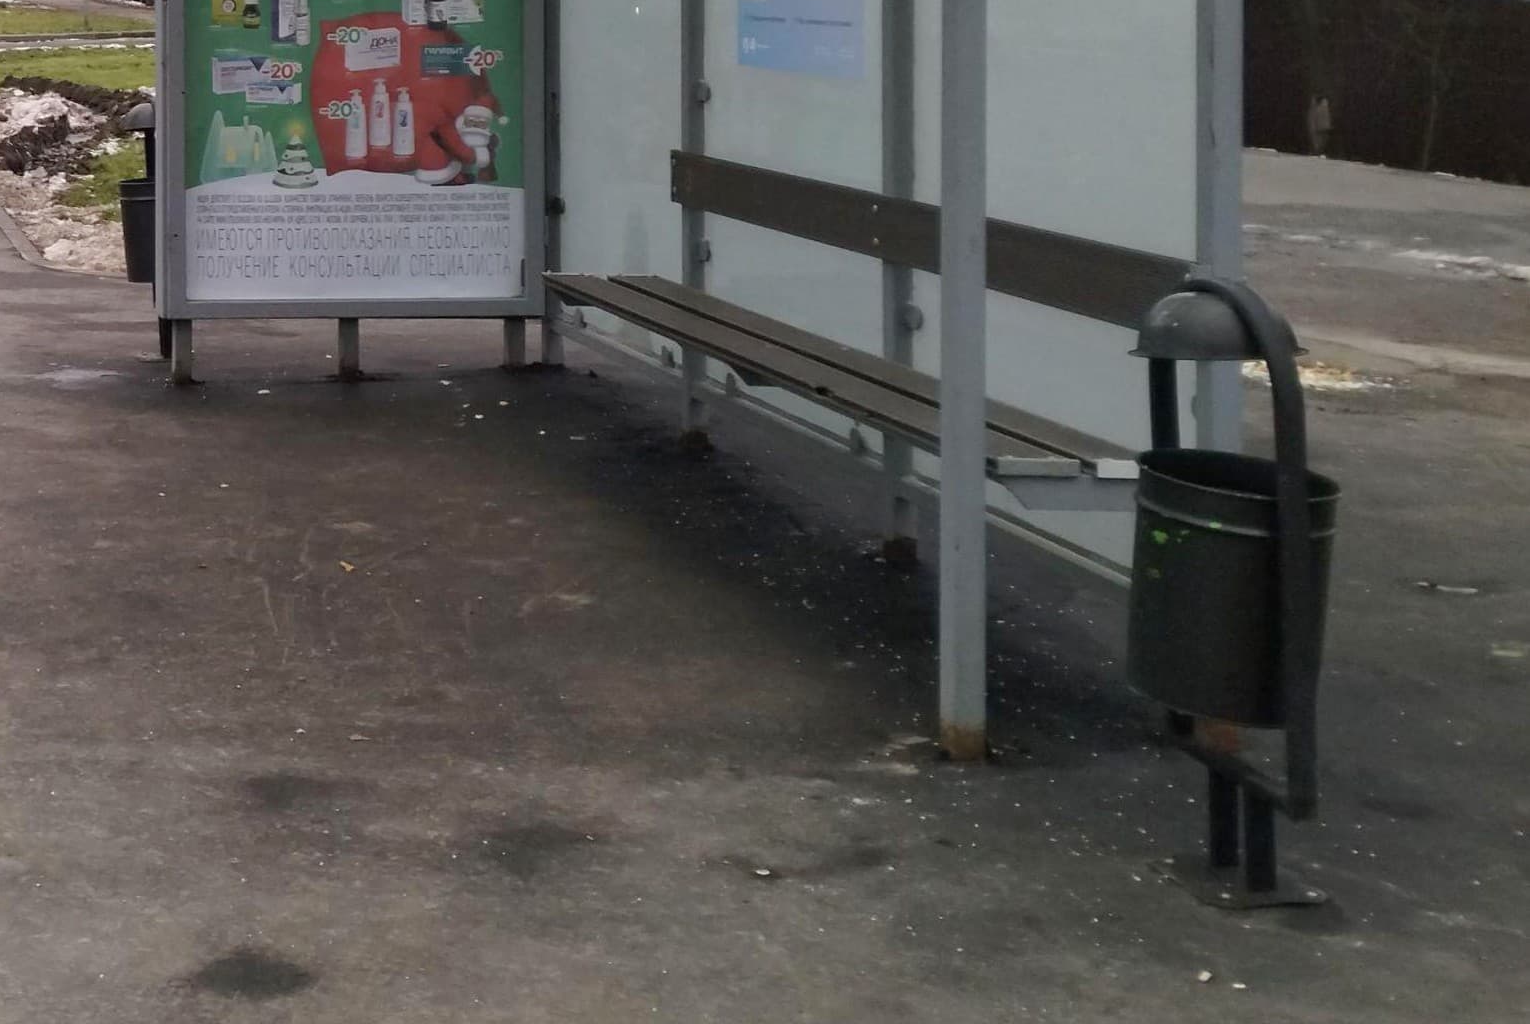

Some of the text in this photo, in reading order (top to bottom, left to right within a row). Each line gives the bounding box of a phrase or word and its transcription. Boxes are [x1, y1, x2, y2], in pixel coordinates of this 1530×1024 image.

[196, 227, 263, 251] ИМЕЮТСЯ
[197, 253, 511, 279] ПОЛУЧЕНИЕ КОНСУЛЬТАЦИИ СПЕЦИАЛИСТА
